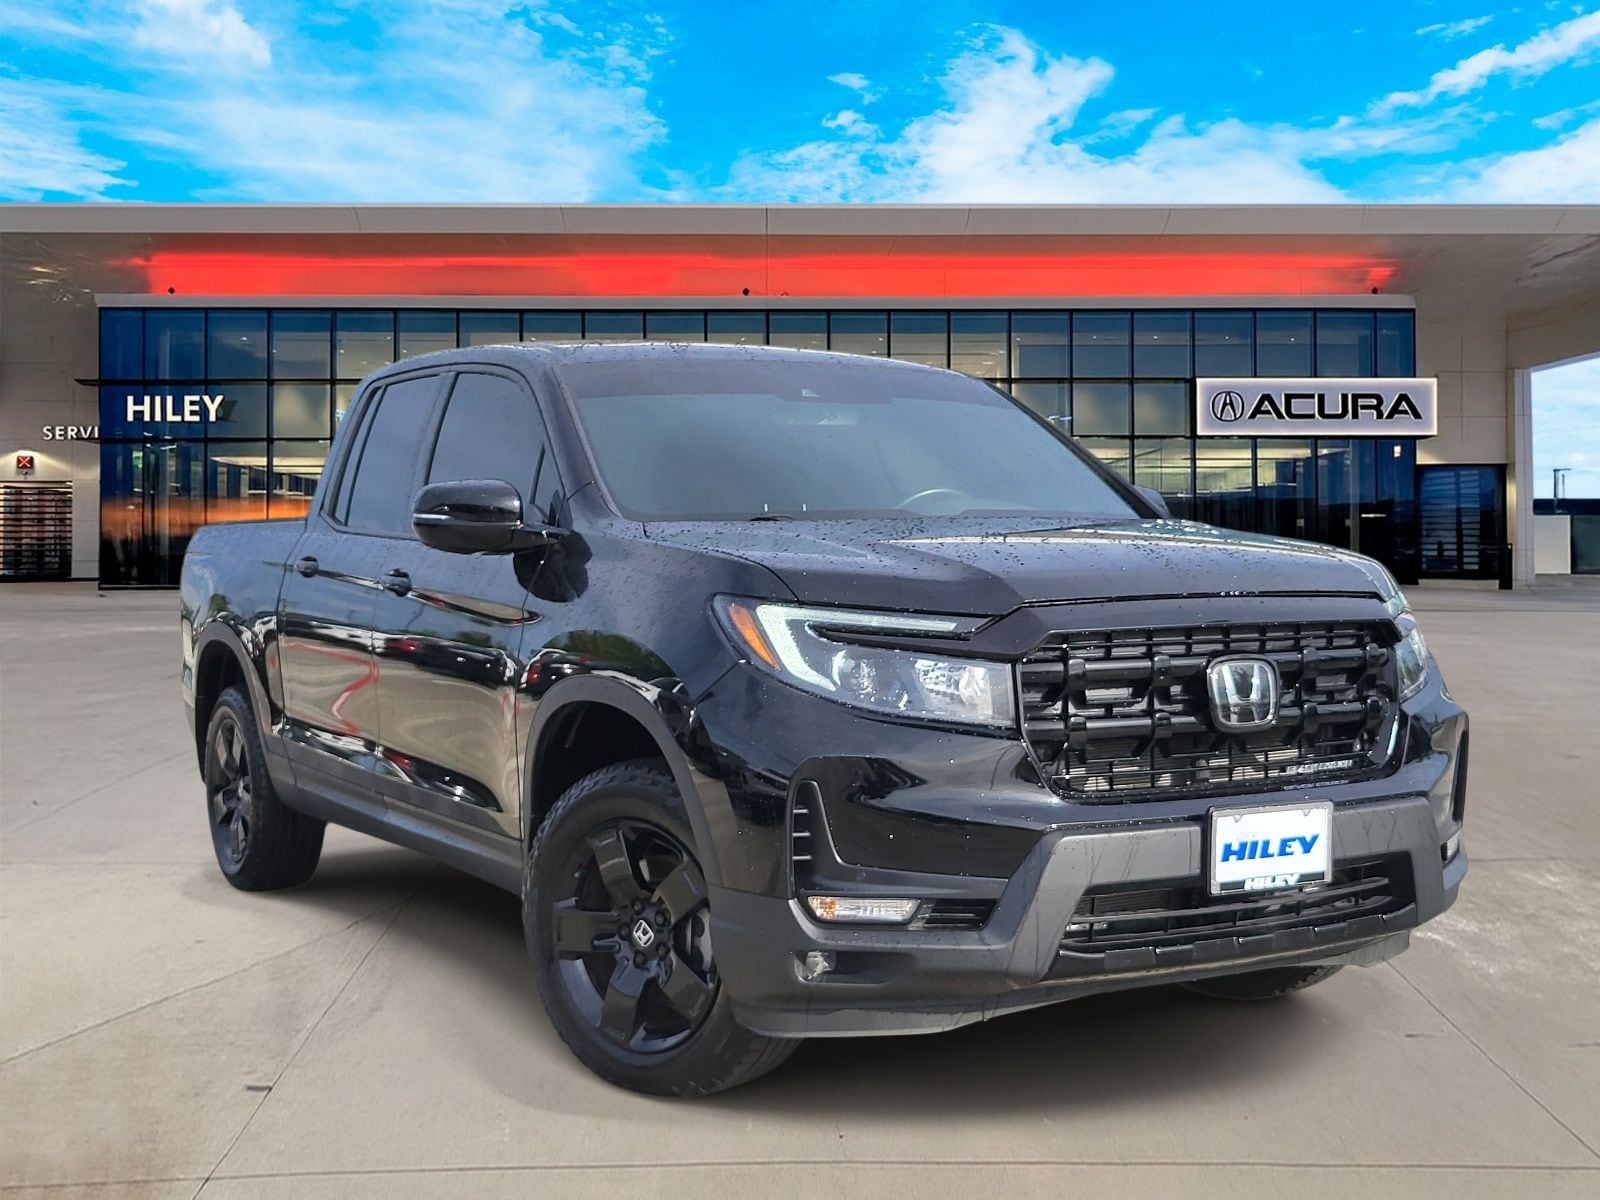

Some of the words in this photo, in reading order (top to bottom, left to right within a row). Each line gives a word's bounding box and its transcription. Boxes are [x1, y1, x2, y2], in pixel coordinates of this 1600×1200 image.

[126, 395, 223, 422] HILEY
[1249, 393, 1422, 420] ACURA
[43, 426, 98, 440] SERVI
[1220, 833, 1319, 862] HILEY
[1244, 873, 1299, 890] HILEY
